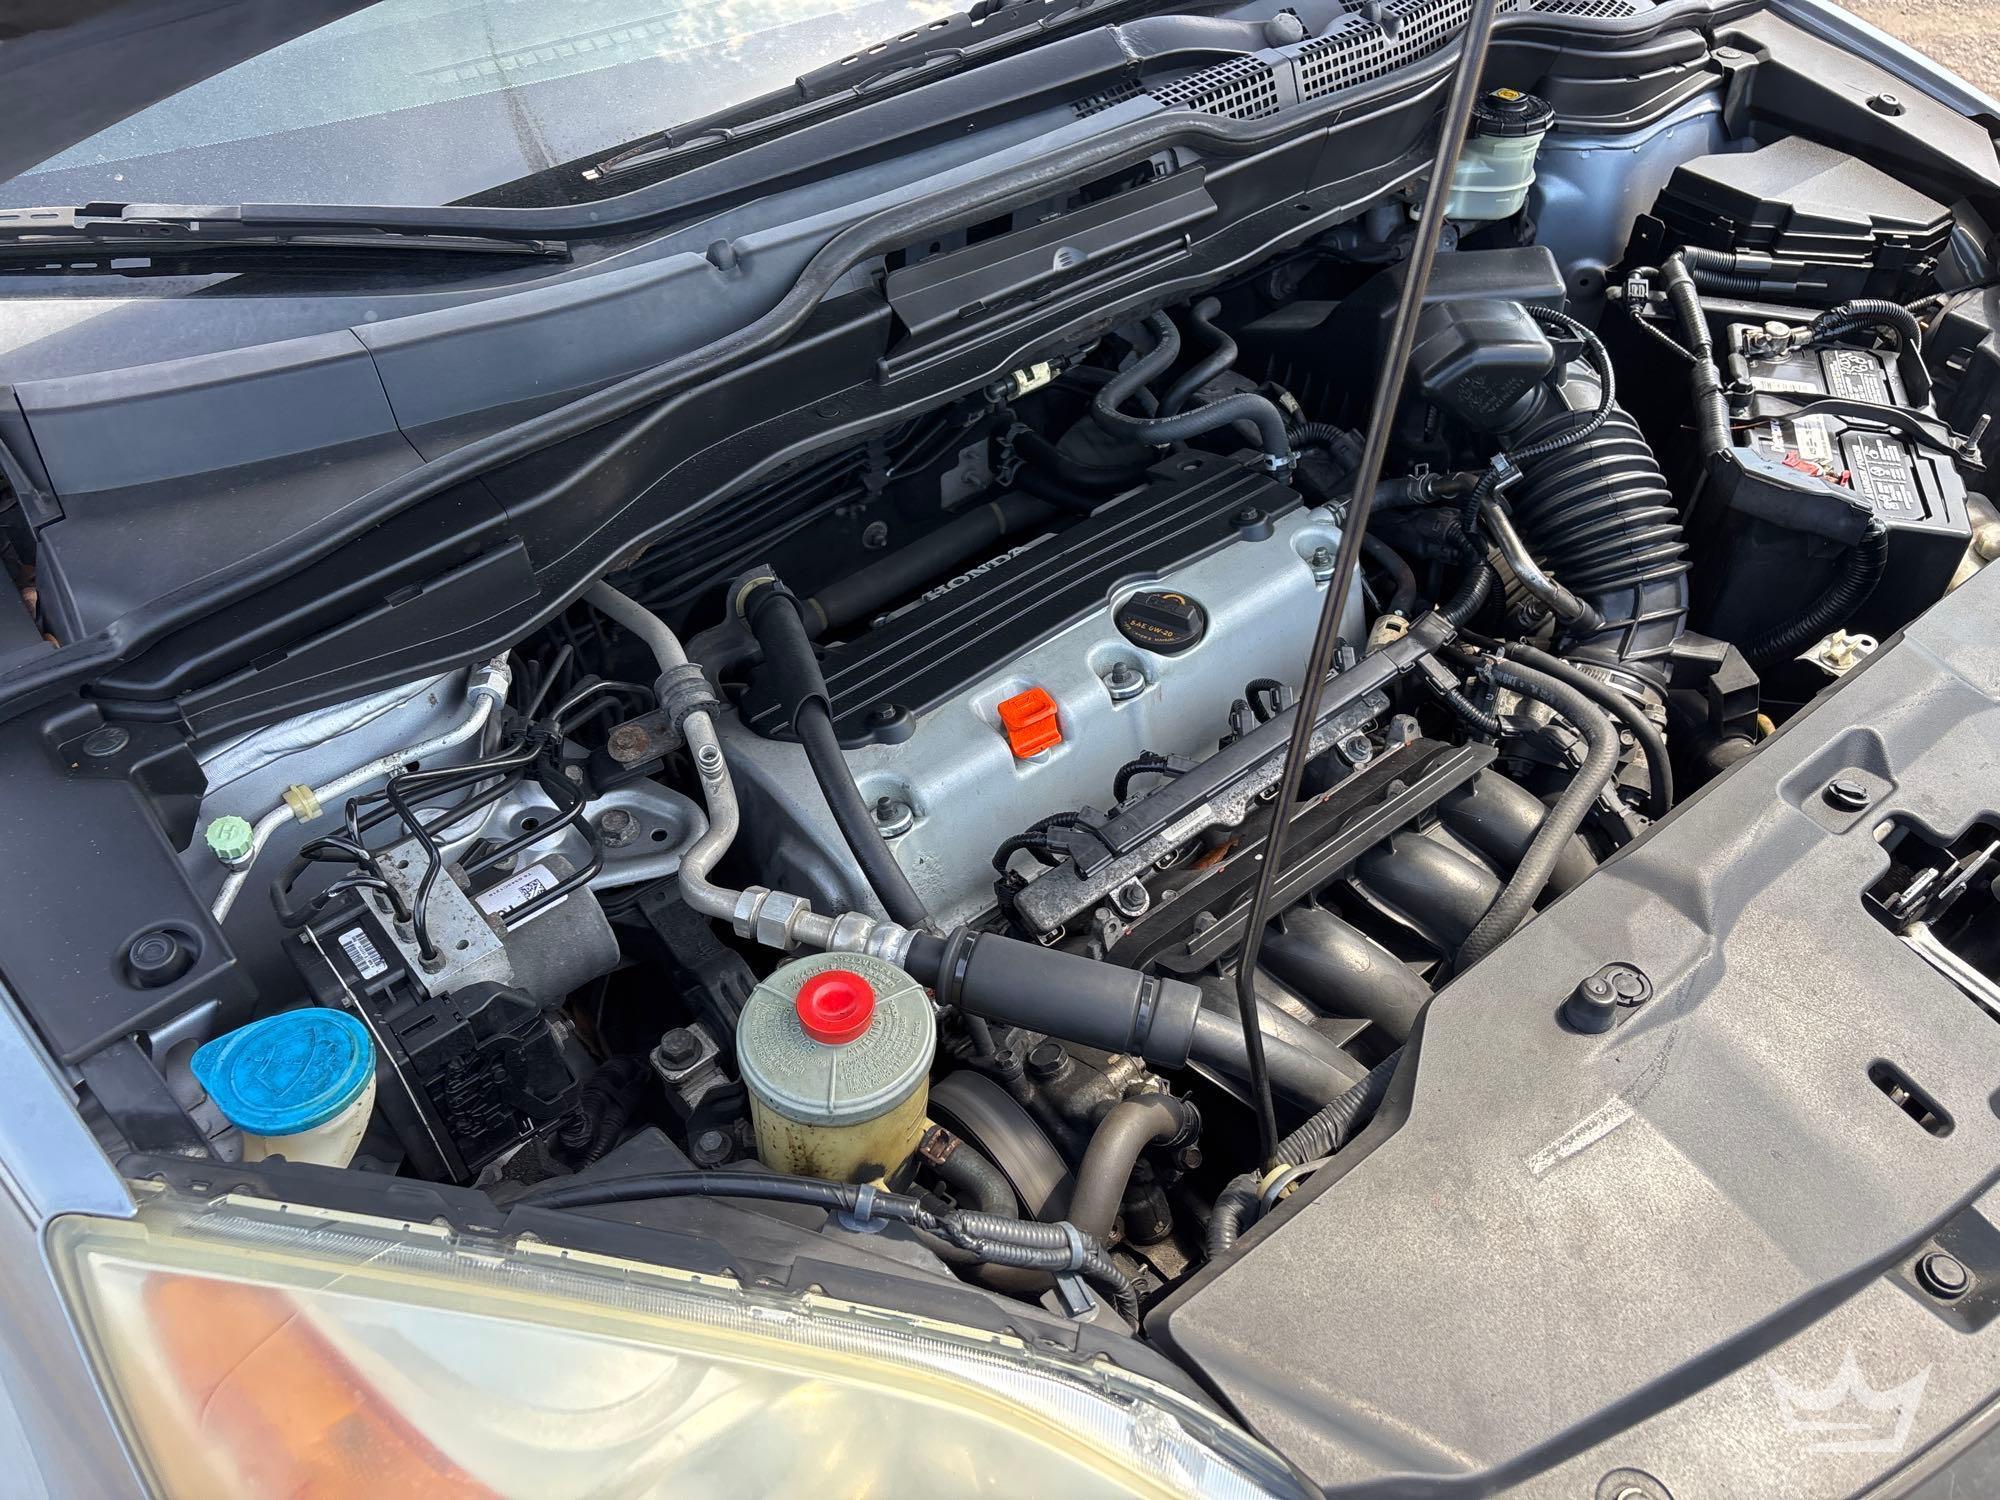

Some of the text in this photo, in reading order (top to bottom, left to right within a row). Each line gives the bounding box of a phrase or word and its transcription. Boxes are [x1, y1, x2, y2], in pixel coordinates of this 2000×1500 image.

[921, 546, 1024, 601] HONDA
[1130, 619, 1174, 638] SAE 0W-20
[847, 1013, 882, 1057] ATTENTION
